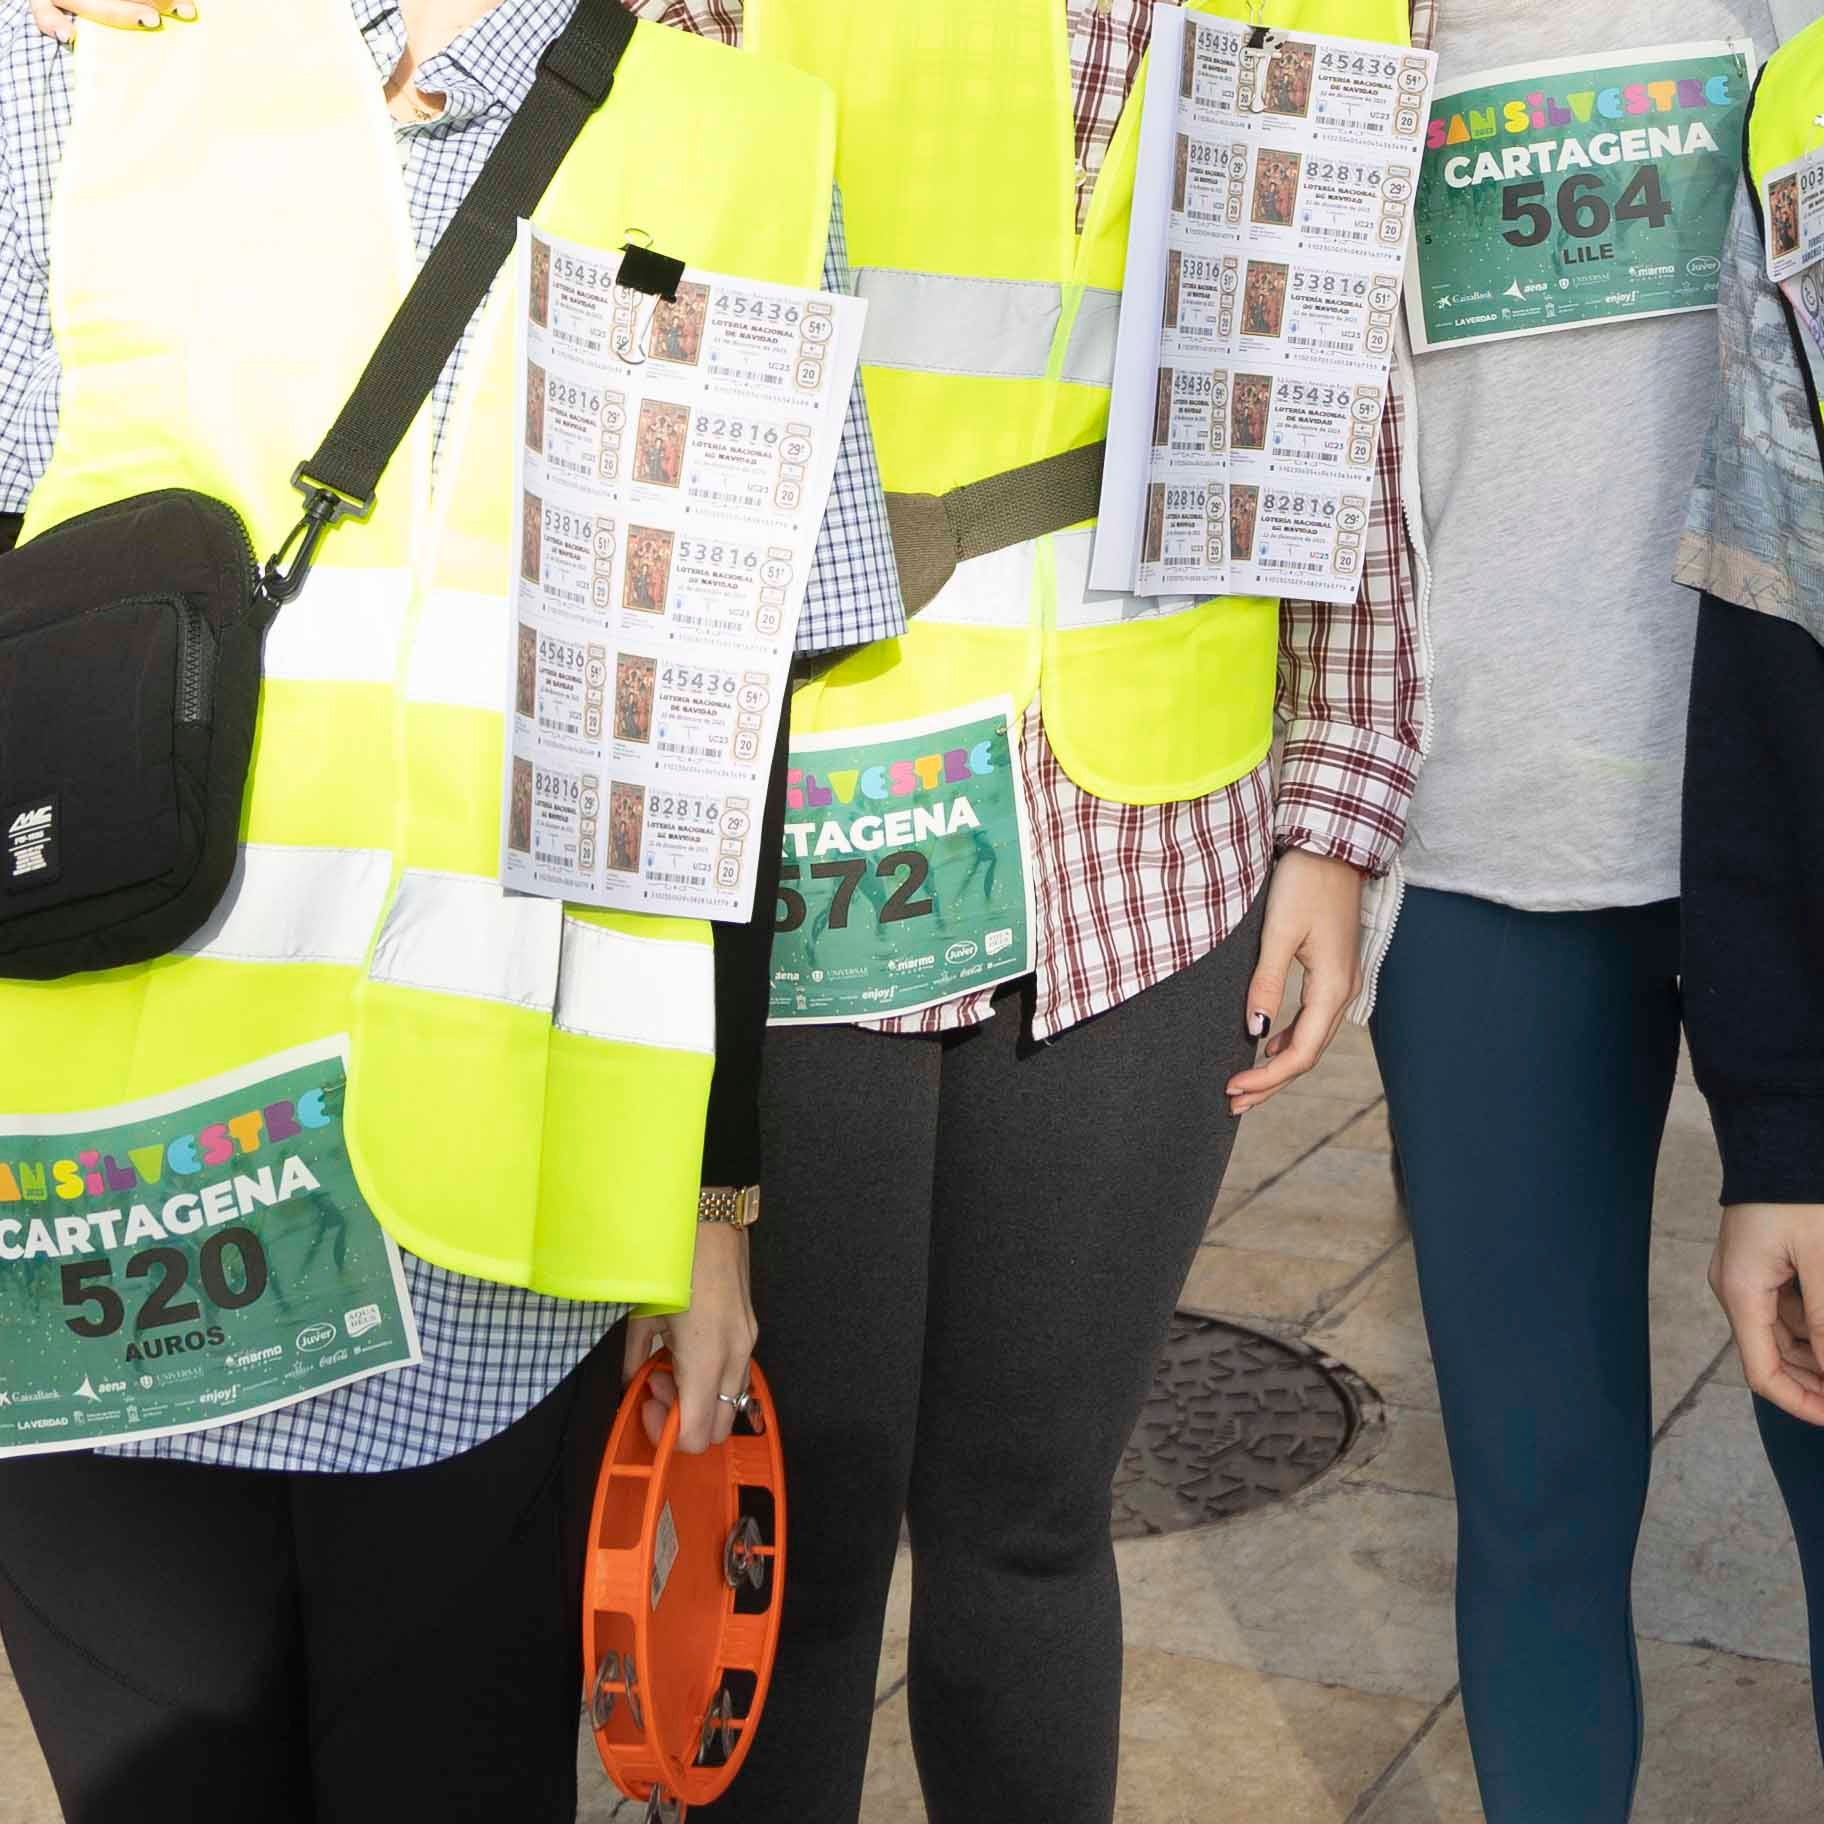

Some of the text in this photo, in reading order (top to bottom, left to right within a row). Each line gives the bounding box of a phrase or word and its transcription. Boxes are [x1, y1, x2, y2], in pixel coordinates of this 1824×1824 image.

[1199, 31, 1238, 53] 45436
[1320, 53, 1397, 76] 45436
[1401, 117, 1412, 126] 20
[1426, 106, 1497, 150] SAN
[1190, 144, 1228, 164] 82816
[1444, 121, 1719, 188] CARTAGENA
[1307, 162, 1381, 184] 82816
[1501, 164, 1672, 248] 564
[1385, 226, 1396, 235] 20
[1563, 243, 1614, 265] LILE
[554, 258, 612, 288] 45436
[1184, 258, 1219, 278] 53816
[1293, 273, 1366, 295] 53816
[715, 295, 799, 322] 45436
[1372, 335, 1383, 344] 20
[802, 368, 815, 379] 20
[1175, 376, 1211, 393] 45436
[549, 381, 600, 411] 82816
[1277, 384, 1350, 406] 45436
[696, 416, 778, 444] 82816
[1355, 446, 1366, 455] 20
[782, 490, 794, 502] 20
[1167, 490, 1205, 506] 82816
[1264, 495, 1334, 514] 82816
[545, 509, 592, 539] 53816
[679, 541, 758, 568] 53816
[1340, 556, 1351, 565] 20
[762, 615, 775, 625] 20
[540, 640, 584, 669] 45436
[662, 668, 736, 694] 45436
[740, 740, 752, 751] 20
[535, 775, 579, 800] 82816
[649, 797, 719, 820] 82816
[723, 867, 734, 877] 20
[60, 1226, 268, 1338] 520
[124, 1326, 225, 1362] AUROS
[237, 1345, 282, 1366] marmo
[98, 1381, 126, 1393] aena
